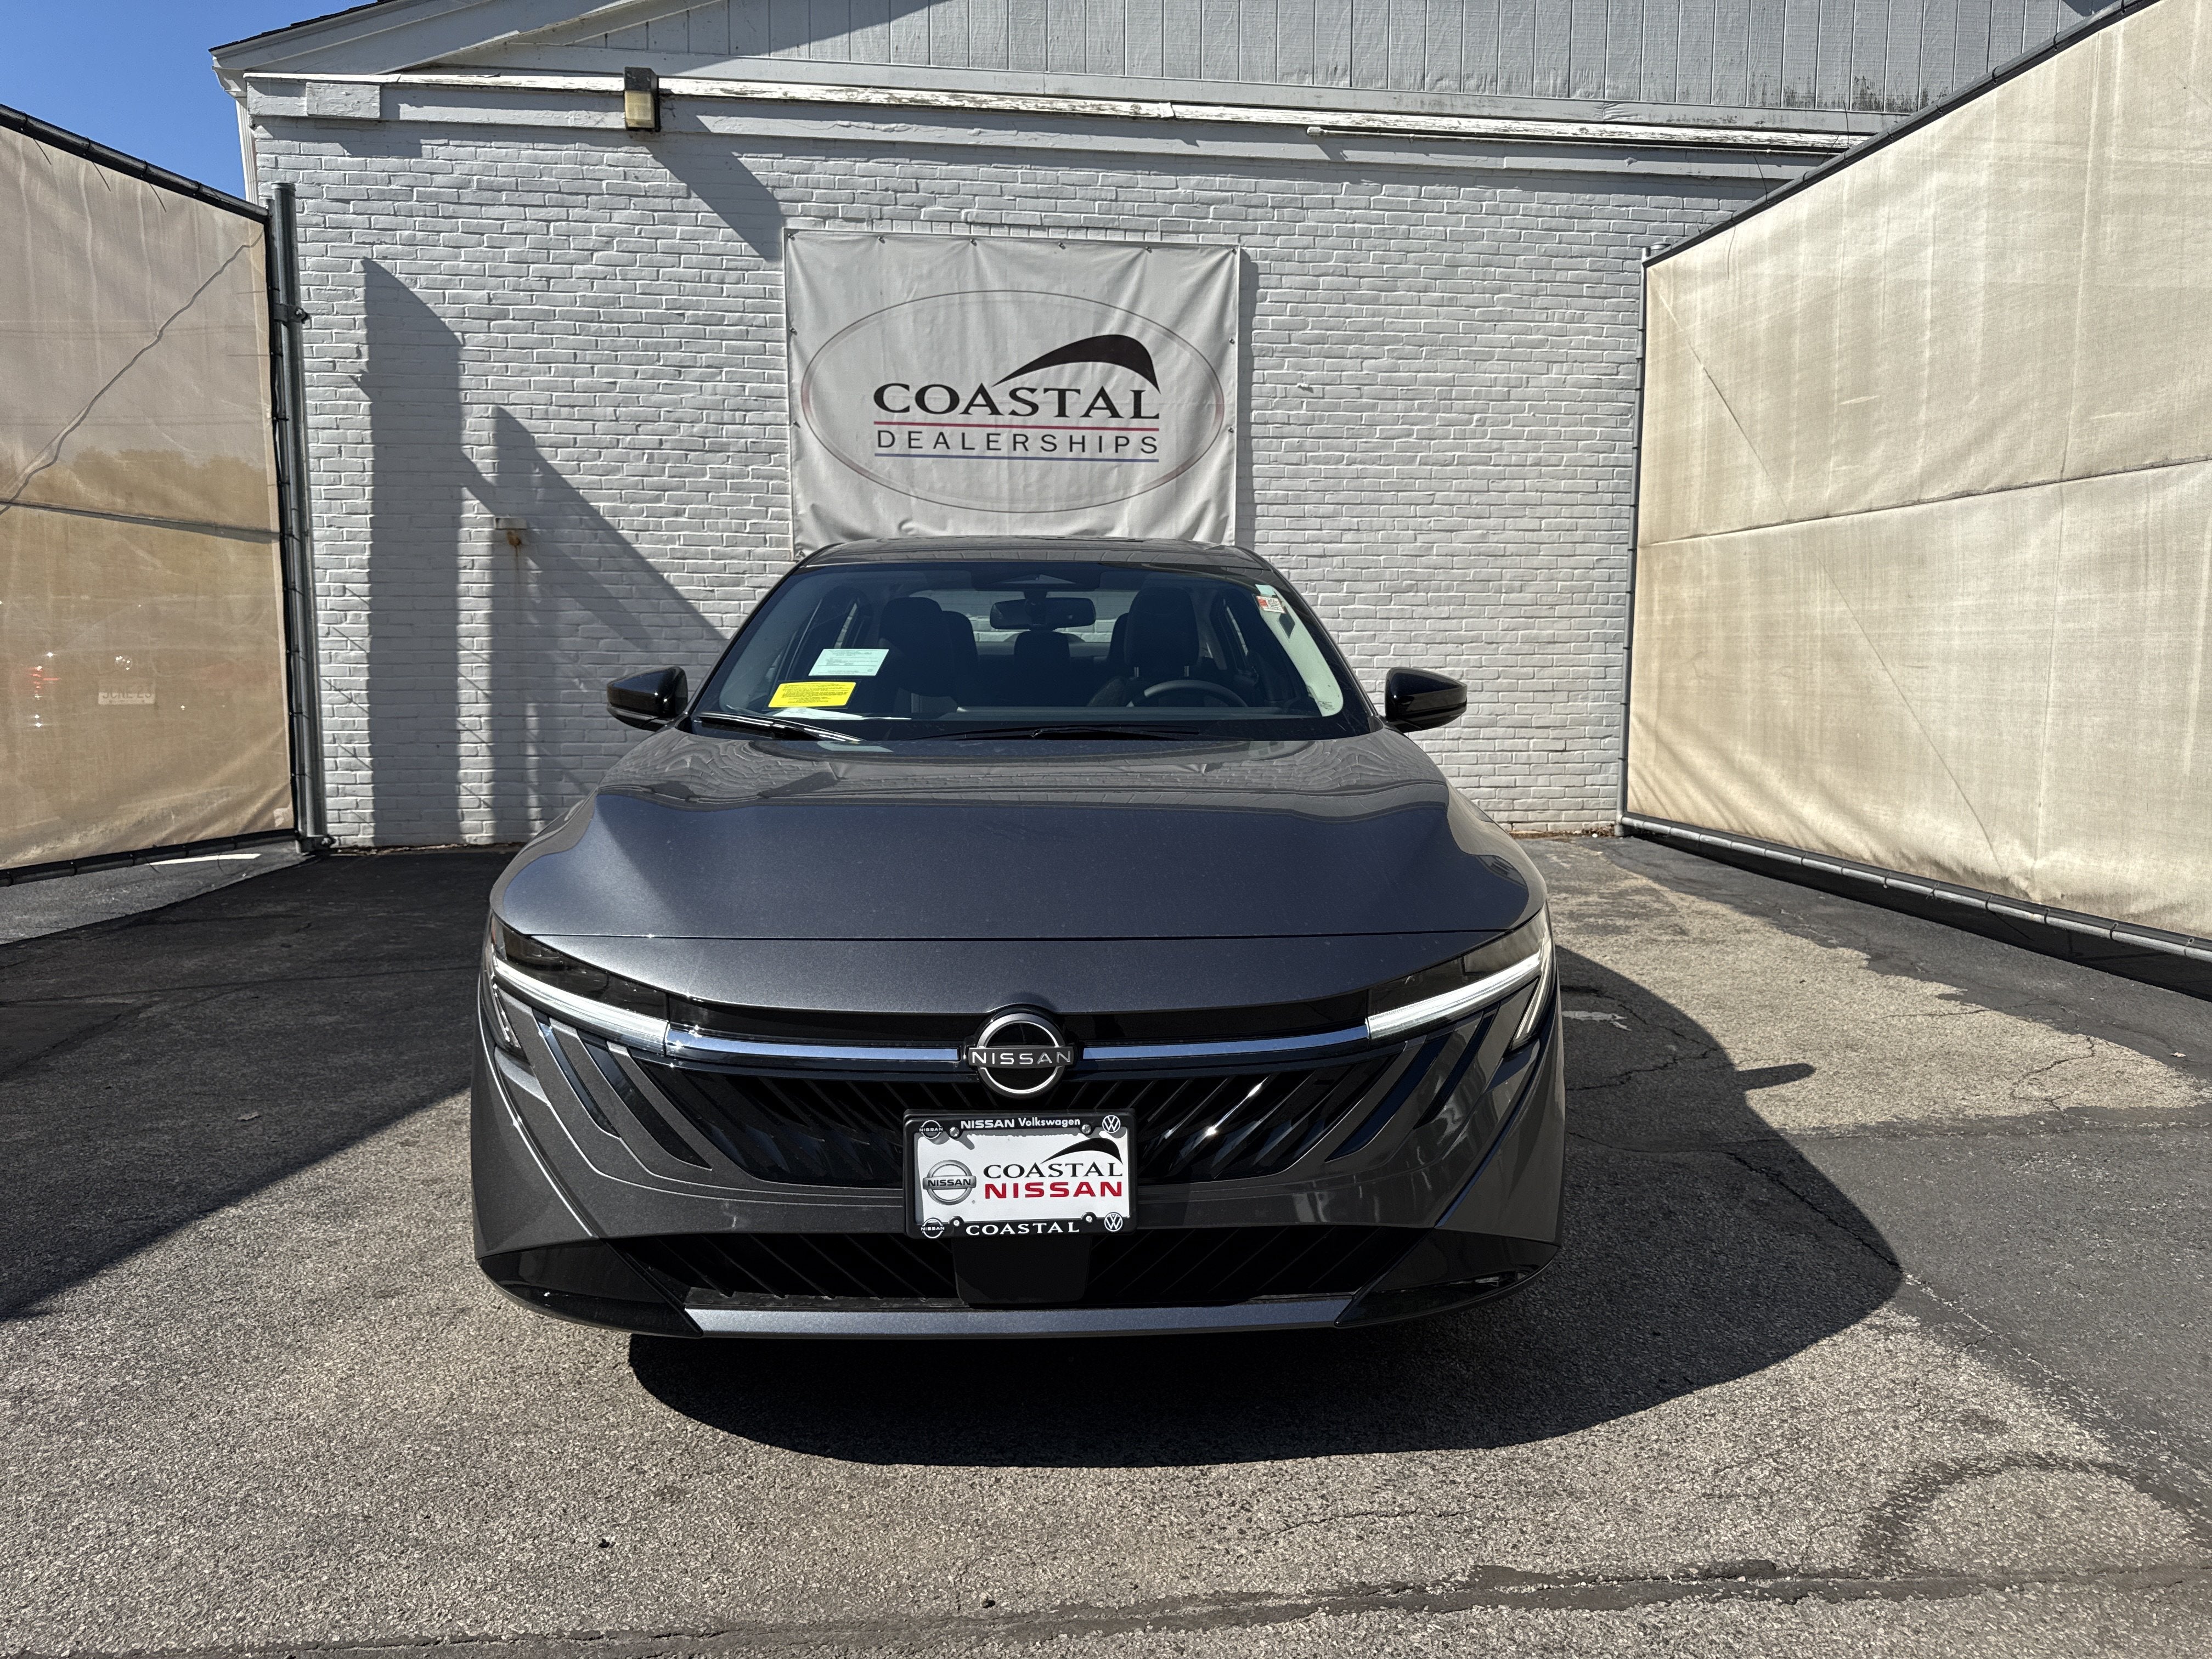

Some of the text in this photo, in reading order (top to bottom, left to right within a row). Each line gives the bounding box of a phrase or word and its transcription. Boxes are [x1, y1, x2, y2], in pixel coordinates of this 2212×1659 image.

[873, 382, 1160, 419] COASTAL
[877, 429, 1158, 454] DEALERSHIPS
[972, 1050, 1071, 1064] NISSAN
[961, 1117, 1080, 1129] NISSAN Volkswagen
[1103, 1115, 1120, 1132] VW
[983, 1161, 1123, 1179] COASTAL
[928, 1178, 971, 1187] NISSAN
[985, 1181, 1122, 1199] NISSAN
[966, 1222, 1080, 1235] COASTAL
[1105, 1213, 1122, 1231] VW
